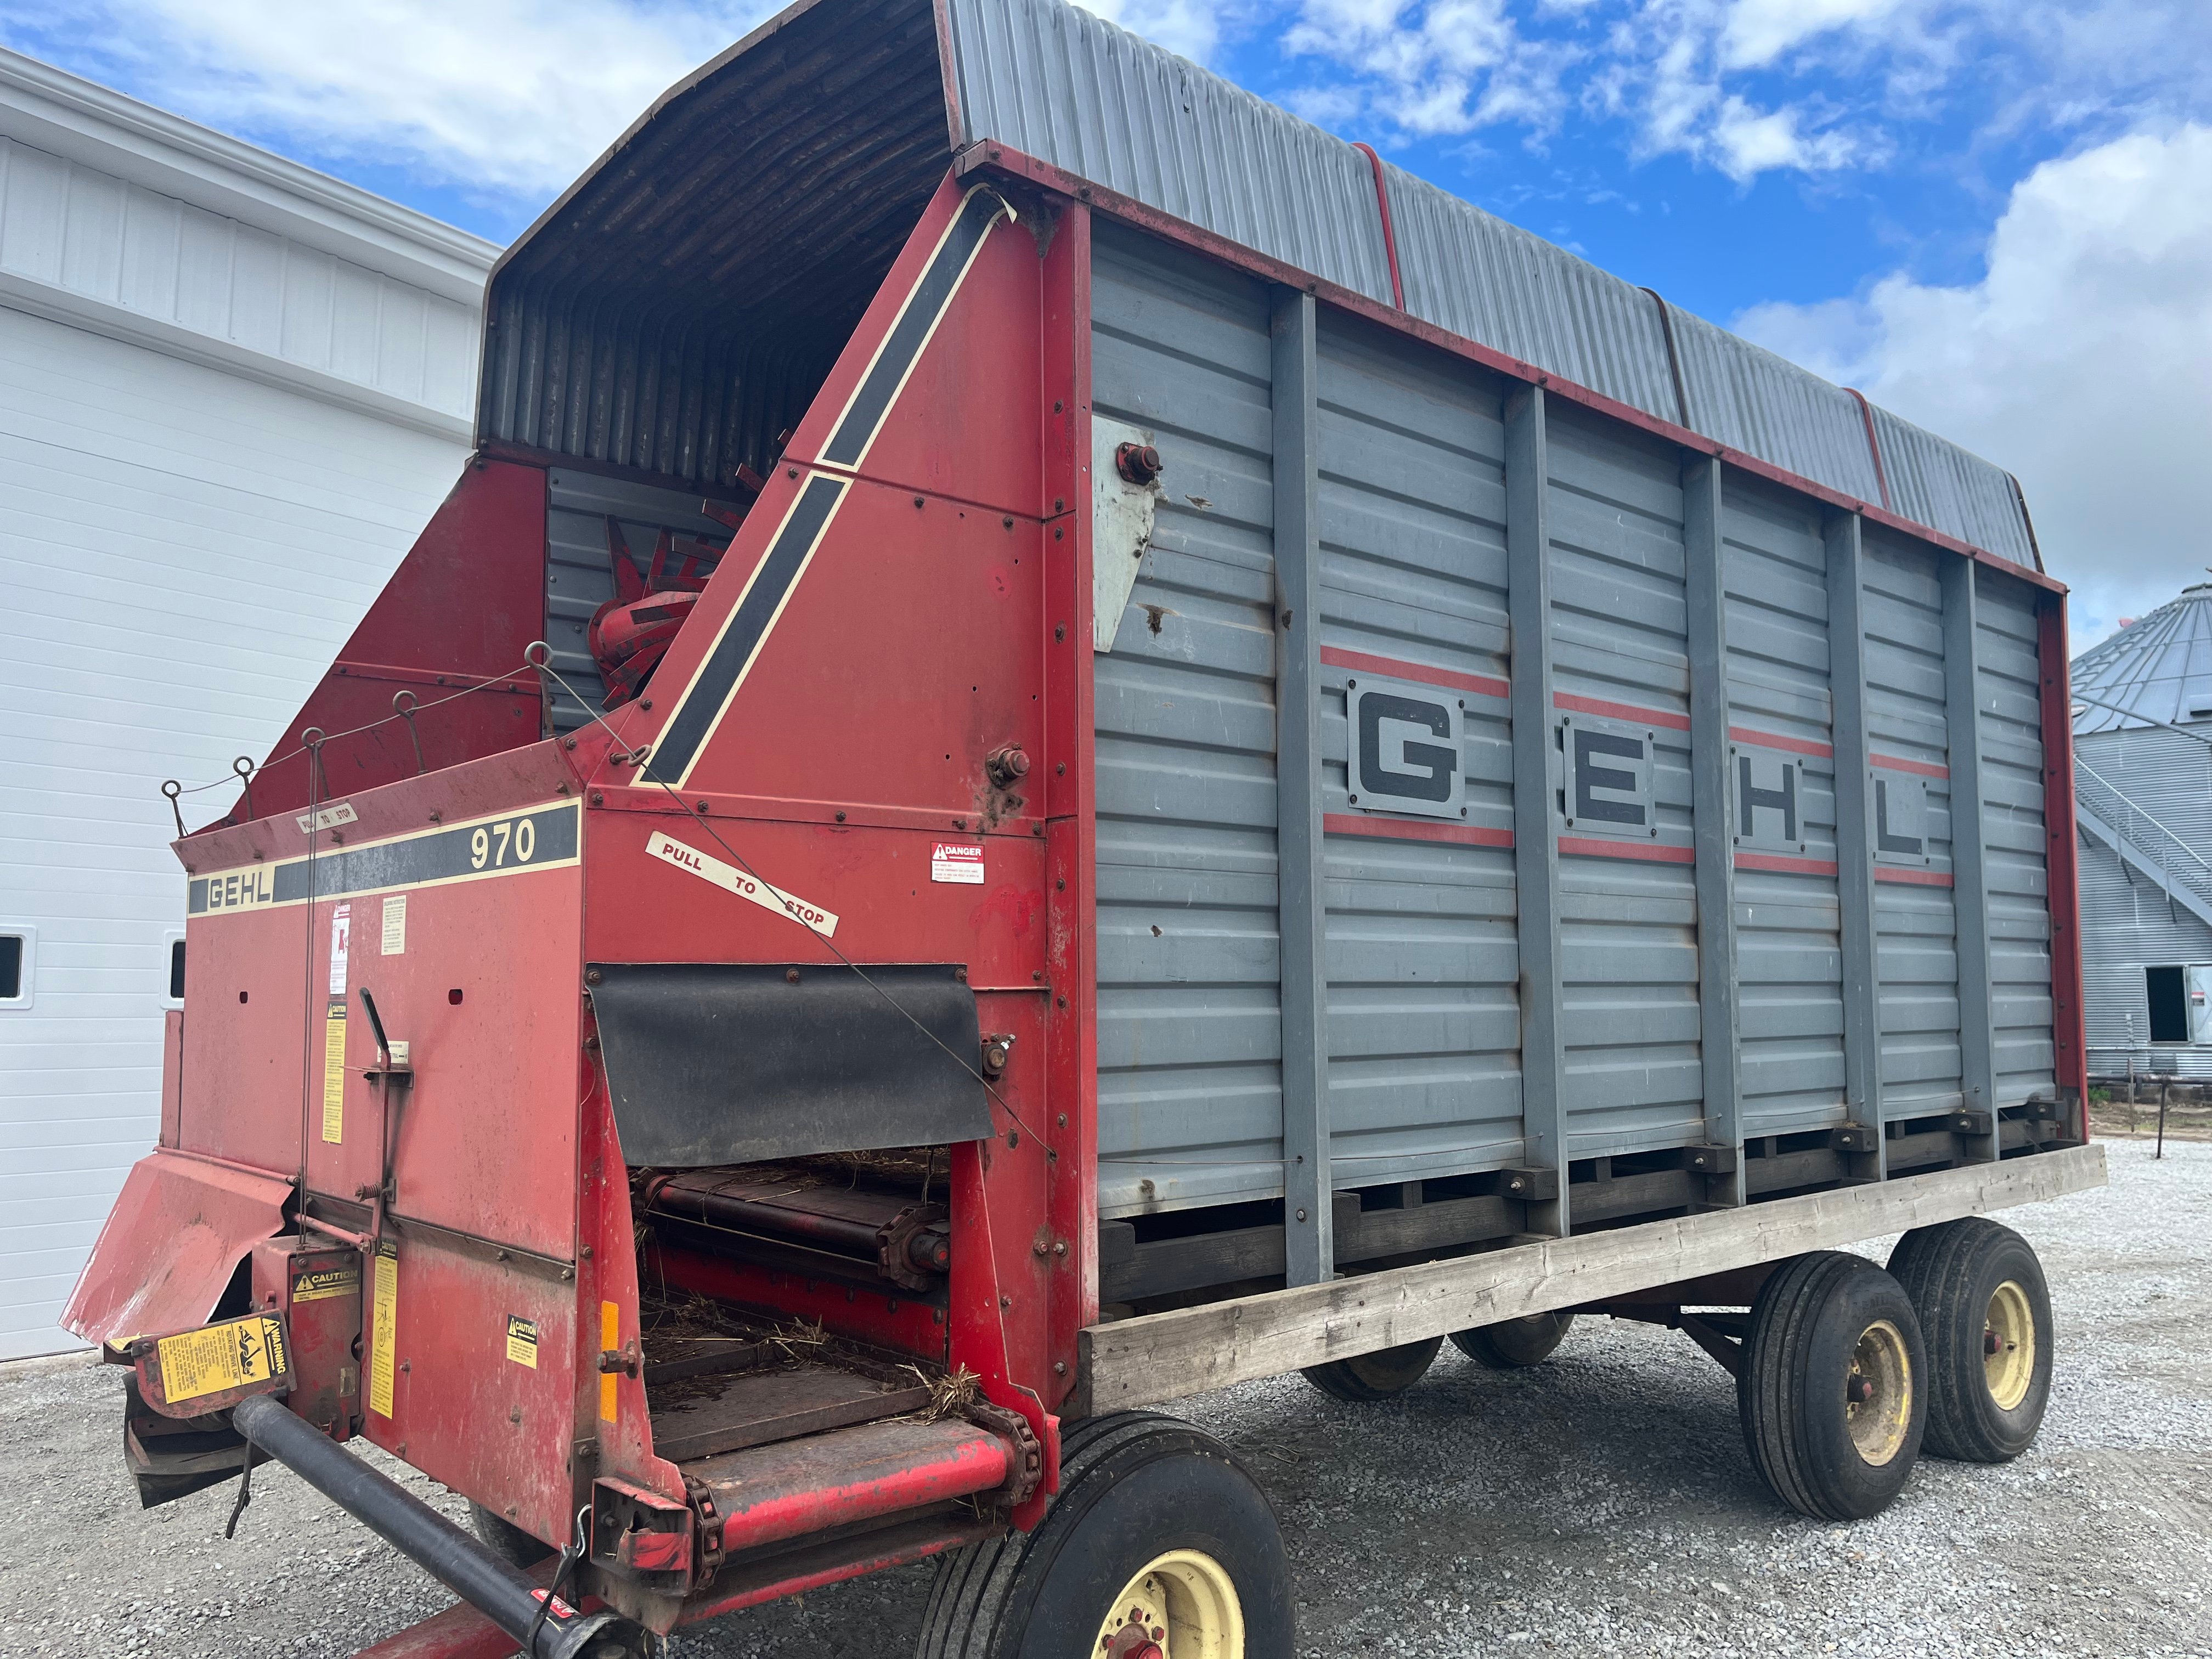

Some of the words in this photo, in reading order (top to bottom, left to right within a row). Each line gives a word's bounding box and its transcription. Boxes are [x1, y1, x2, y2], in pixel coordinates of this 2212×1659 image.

[321, 815, 330, 824] TO
[336, 808, 351, 820] STOP
[471, 819, 535, 869] 970
[945, 846, 981, 856] DANGER
[210, 871, 270, 908] GEHL
[662, 843, 702, 871] PULL
[736, 876, 756, 894] TO
[785, 900, 824, 924] STOP
[312, 1270, 358, 1283] CAUTION
[515, 1321, 537, 1336] CAUTION
[226, 1330, 234, 1353] ROTATING
[271, 1328, 286, 1374] WARNING
